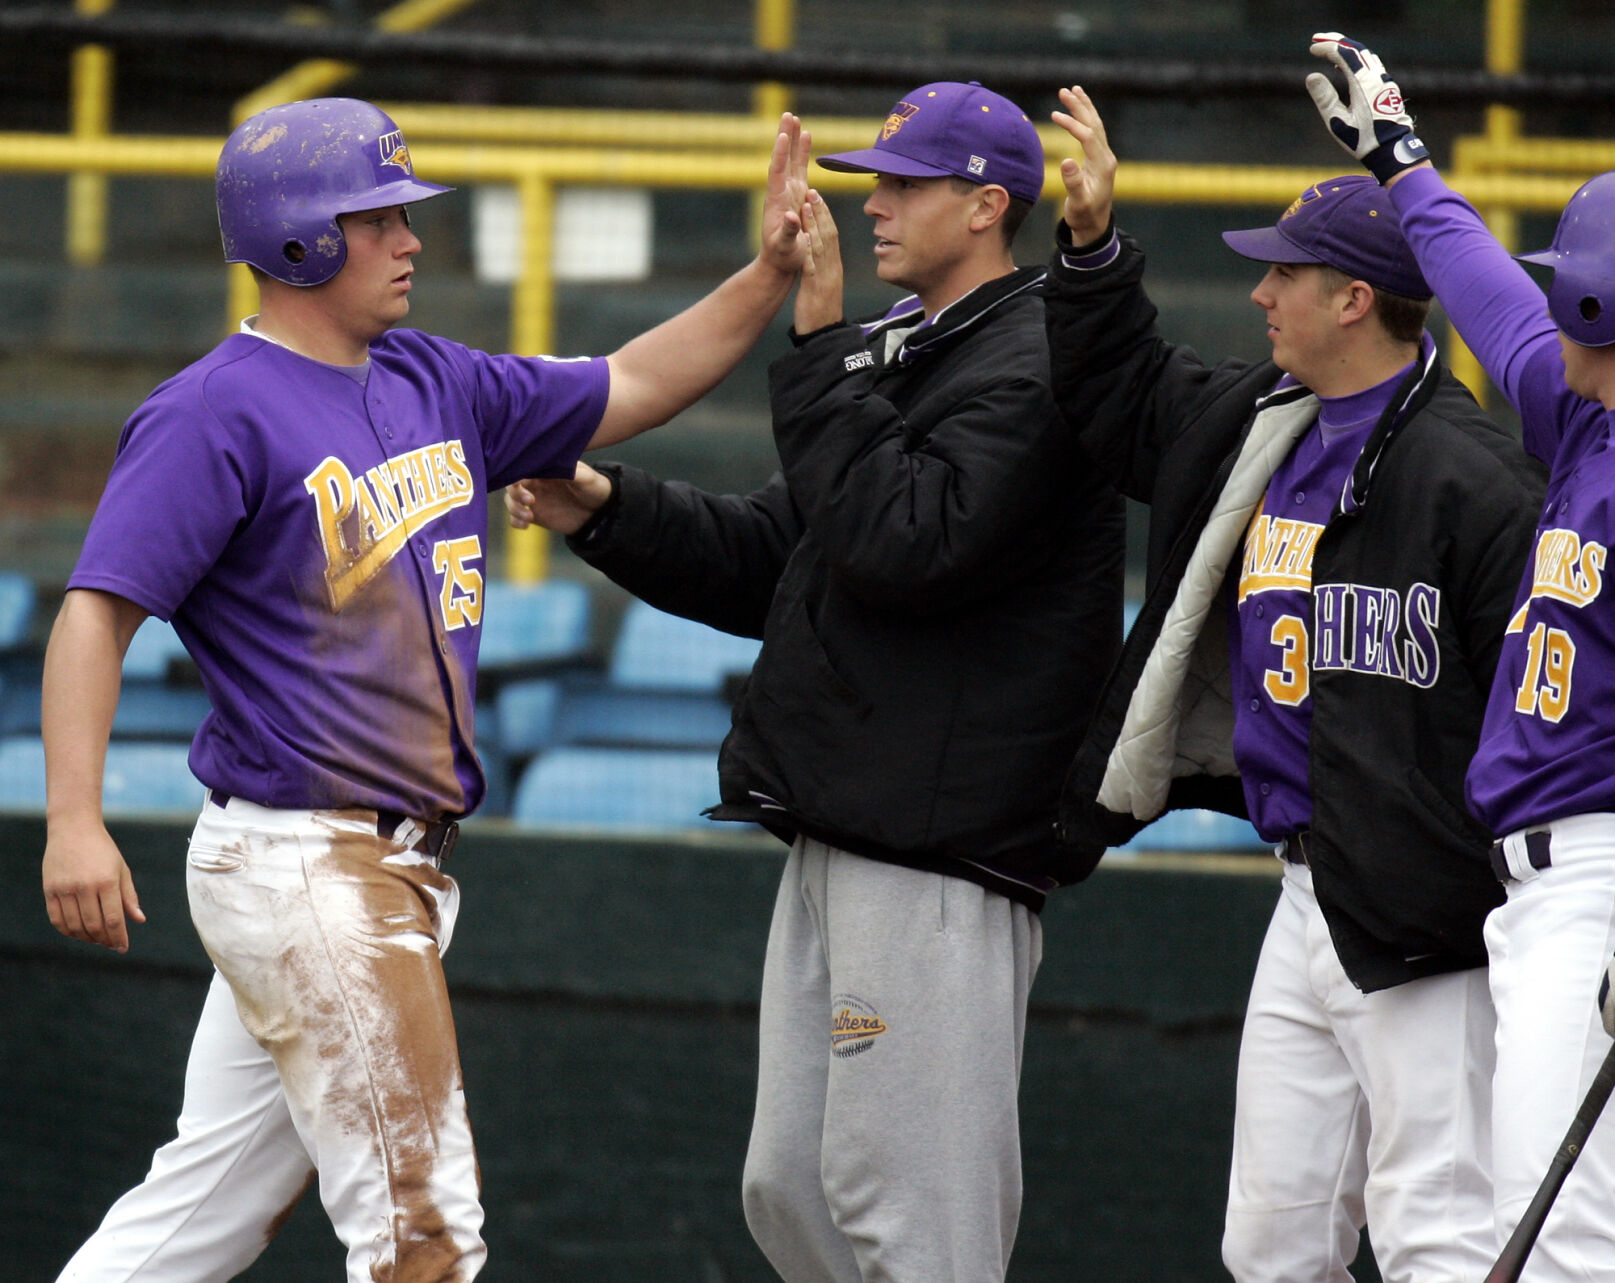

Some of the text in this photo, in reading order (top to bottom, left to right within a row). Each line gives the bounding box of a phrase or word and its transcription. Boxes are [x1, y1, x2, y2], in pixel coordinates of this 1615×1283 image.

[303, 439, 474, 580] PANTHES
[432, 535, 483, 631] 25
[1263, 614, 1310, 707] 3
[1313, 582, 1440, 688] HERS
[1515, 621, 1576, 724] 19
